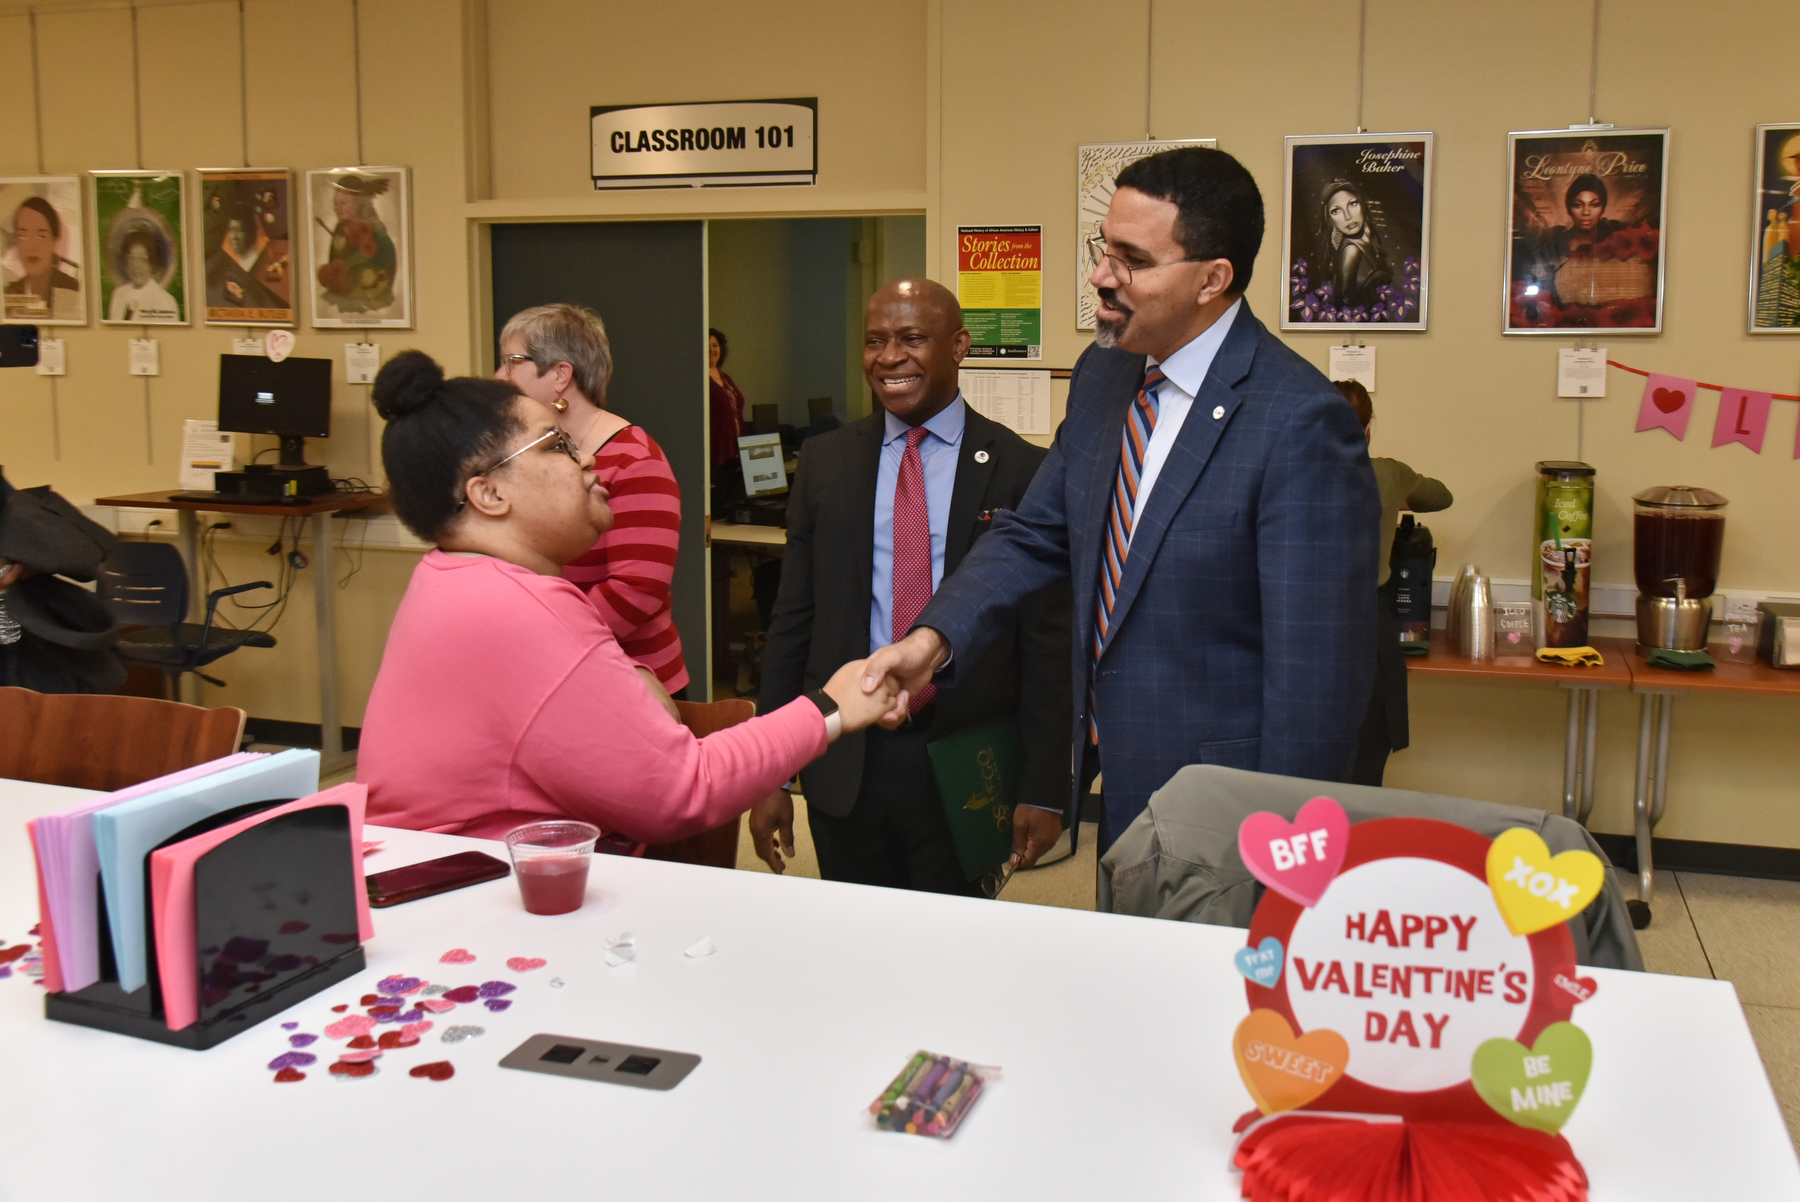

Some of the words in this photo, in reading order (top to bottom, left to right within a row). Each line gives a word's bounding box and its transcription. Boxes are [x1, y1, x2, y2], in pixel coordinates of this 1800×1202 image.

[611, 126, 746, 153] CLASSROOM
[755, 125, 794, 149] 101
[1355, 147, 1422, 165] Josephine
[1361, 160, 1406, 173] Baker
[1519, 154, 1592, 183] Leontyne
[1595, 151, 1649, 177] Price
[962, 235, 1011, 253] Stories
[1010, 242, 1024, 252] from
[1023, 241, 1033, 250] the
[969, 251, 1039, 270] Collection
[1735, 396, 1750, 435] L
[1553, 499, 1576, 508] Iced
[1557, 510, 1589, 522] Coffee
[1500, 618, 1531, 630] COFFEE
[1727, 623, 1748, 633] TEA
[1268, 828, 1329, 872] BFF
[1503, 855, 1580, 910] XOX
[1345, 909, 1478, 952] HAPPY
[1292, 956, 1528, 1005] VALENTINE'S
[1364, 1009, 1451, 1050] DAY
[1244, 1038, 1335, 1085] SWEET
[1522, 1054, 1553, 1079] BE
[1510, 1080, 1574, 1113] MINE
